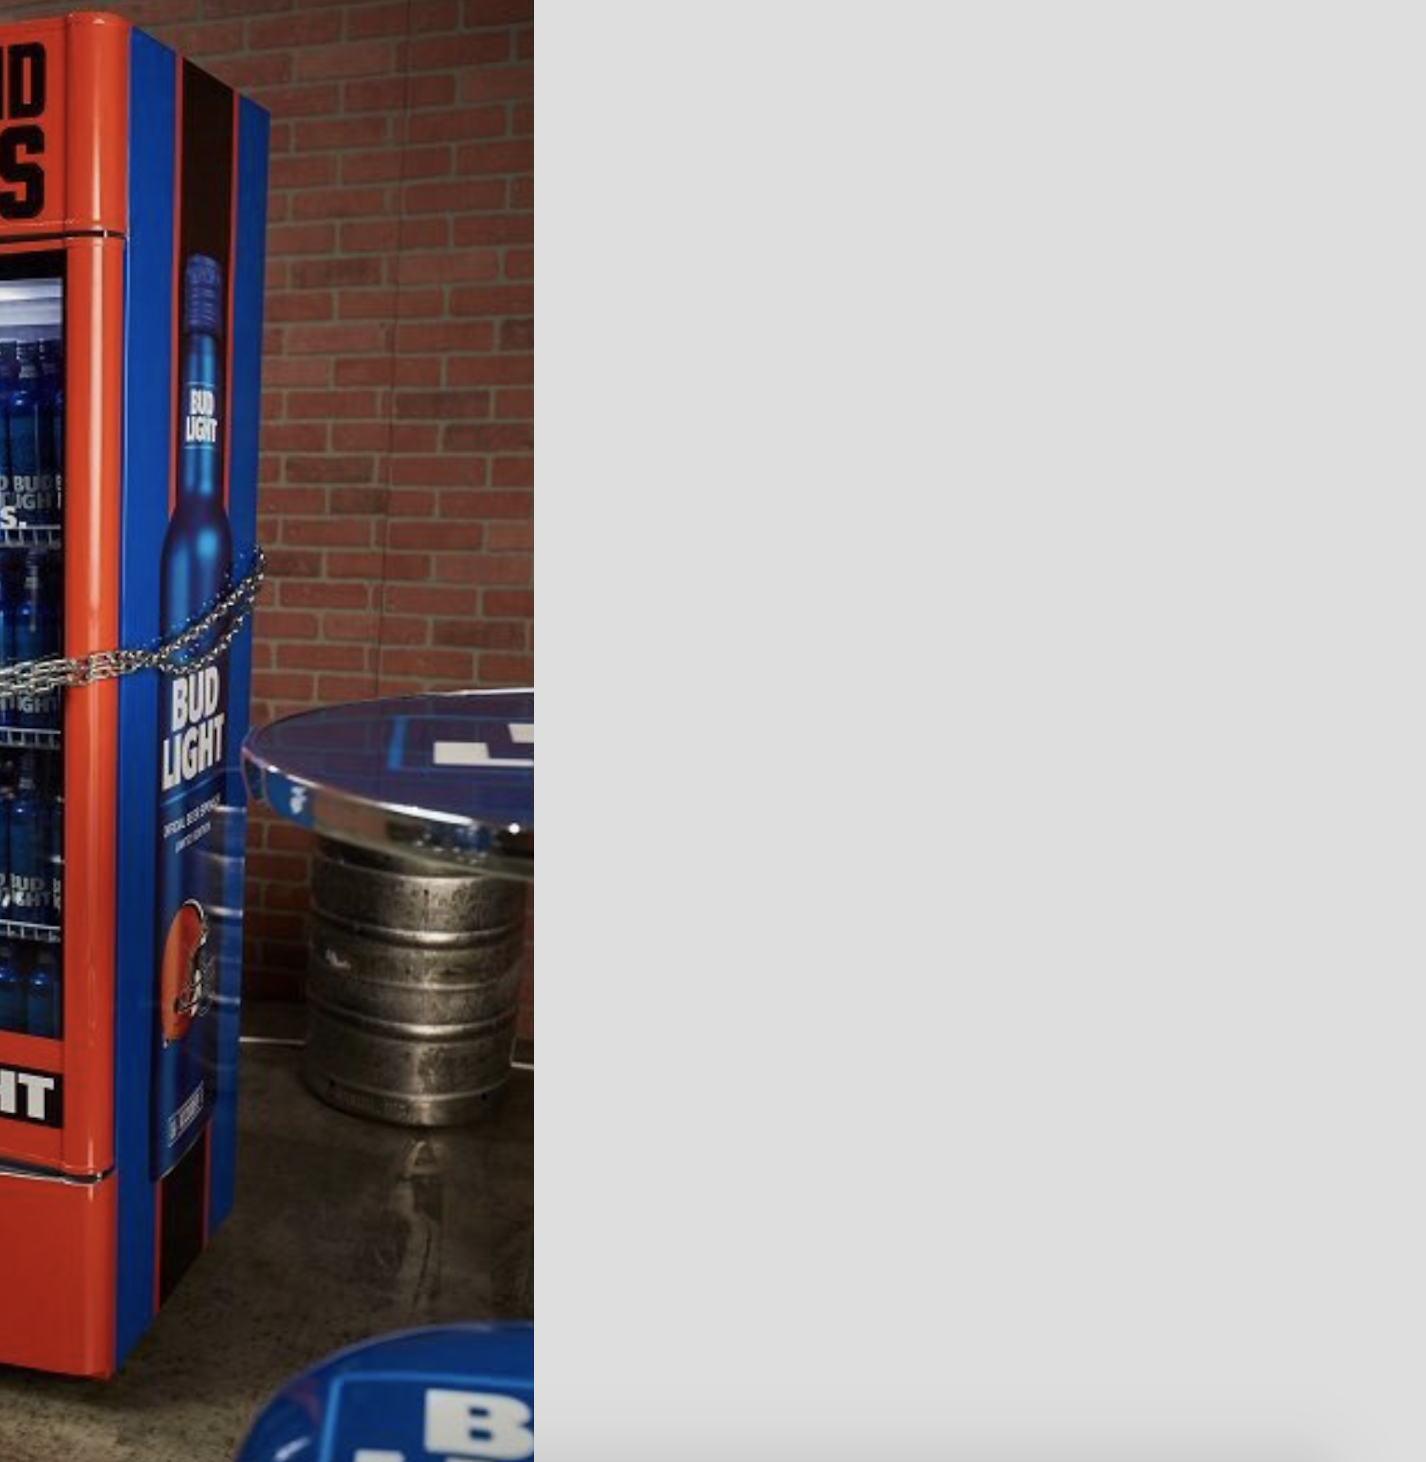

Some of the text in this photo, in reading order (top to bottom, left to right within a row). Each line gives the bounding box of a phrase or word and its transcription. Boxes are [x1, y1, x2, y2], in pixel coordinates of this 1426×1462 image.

[190, 388, 216, 416] BUD
[186, 415, 218, 443] LIGHT
[171, 665, 220, 732] BUD
[162, 712, 225, 791] LIGHT
